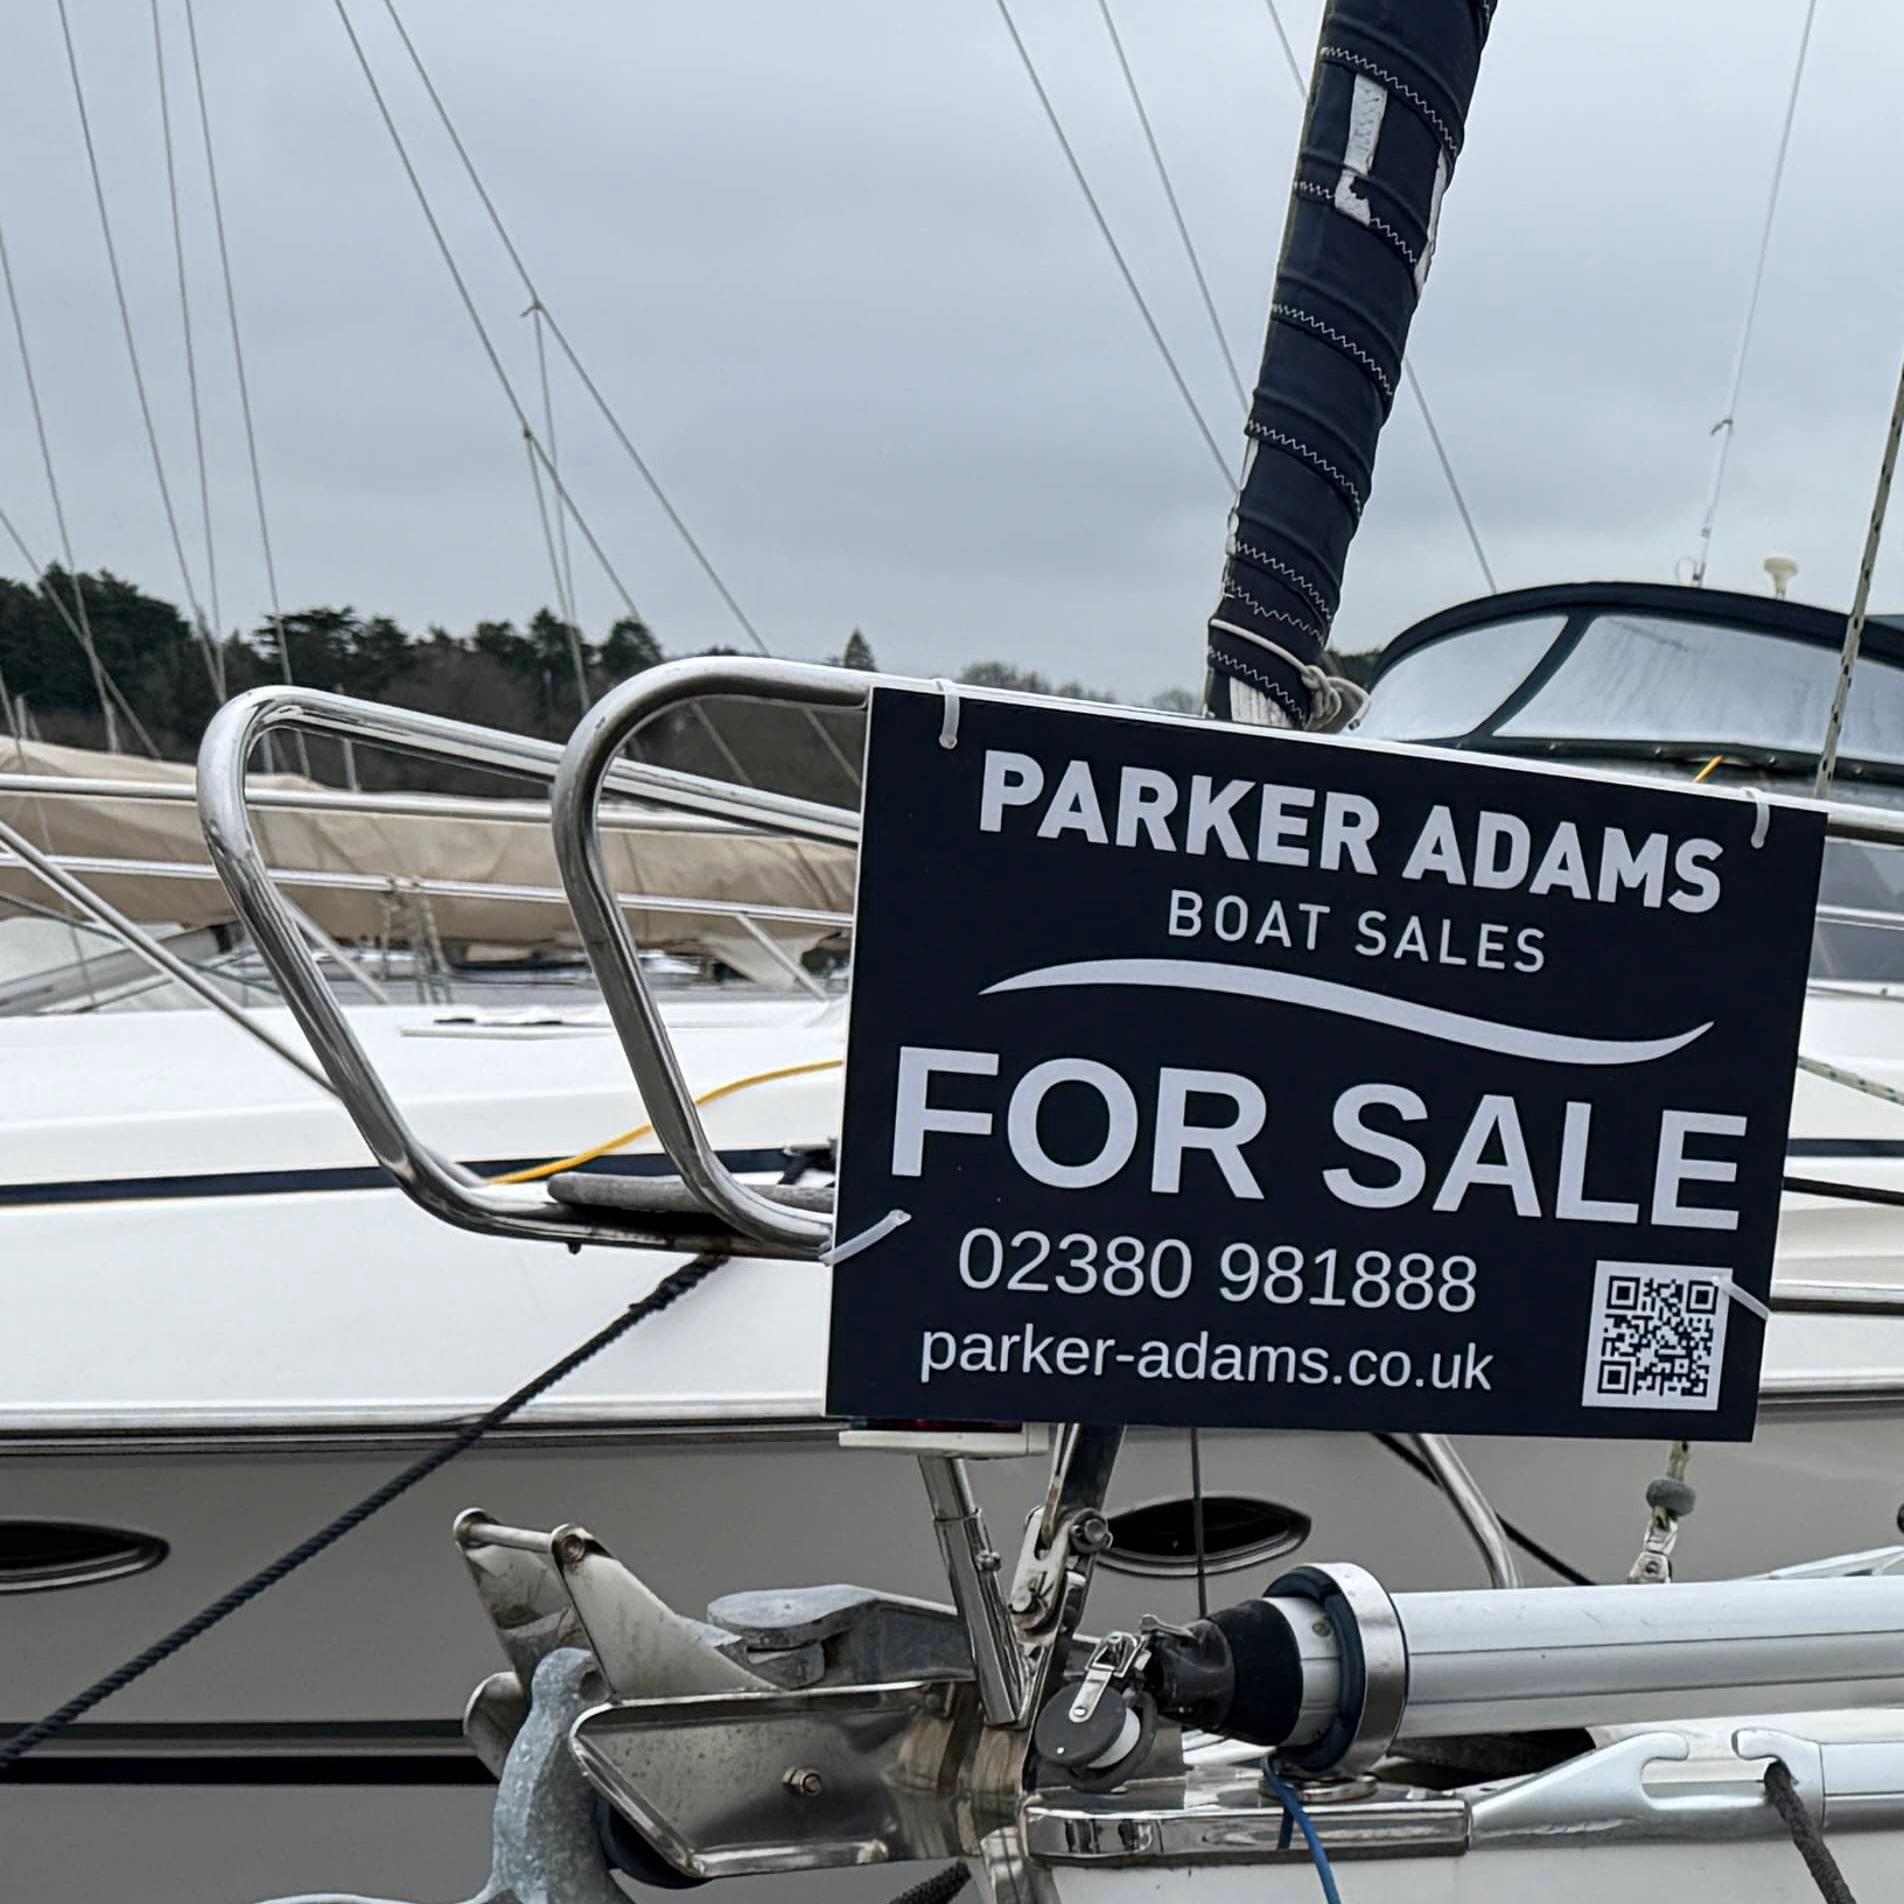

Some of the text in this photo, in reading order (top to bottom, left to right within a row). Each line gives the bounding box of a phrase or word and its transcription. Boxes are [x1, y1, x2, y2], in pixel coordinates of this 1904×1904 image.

[979, 749, 1723, 913] PARKER ADAMS
[1168, 889, 1545, 973] BOAT SALES
[891, 1046, 1748, 1230] FOR SALE
[959, 1227, 1477, 1313] 02380 981888
[921, 1323, 1493, 1390] parker-adams.co.uk
